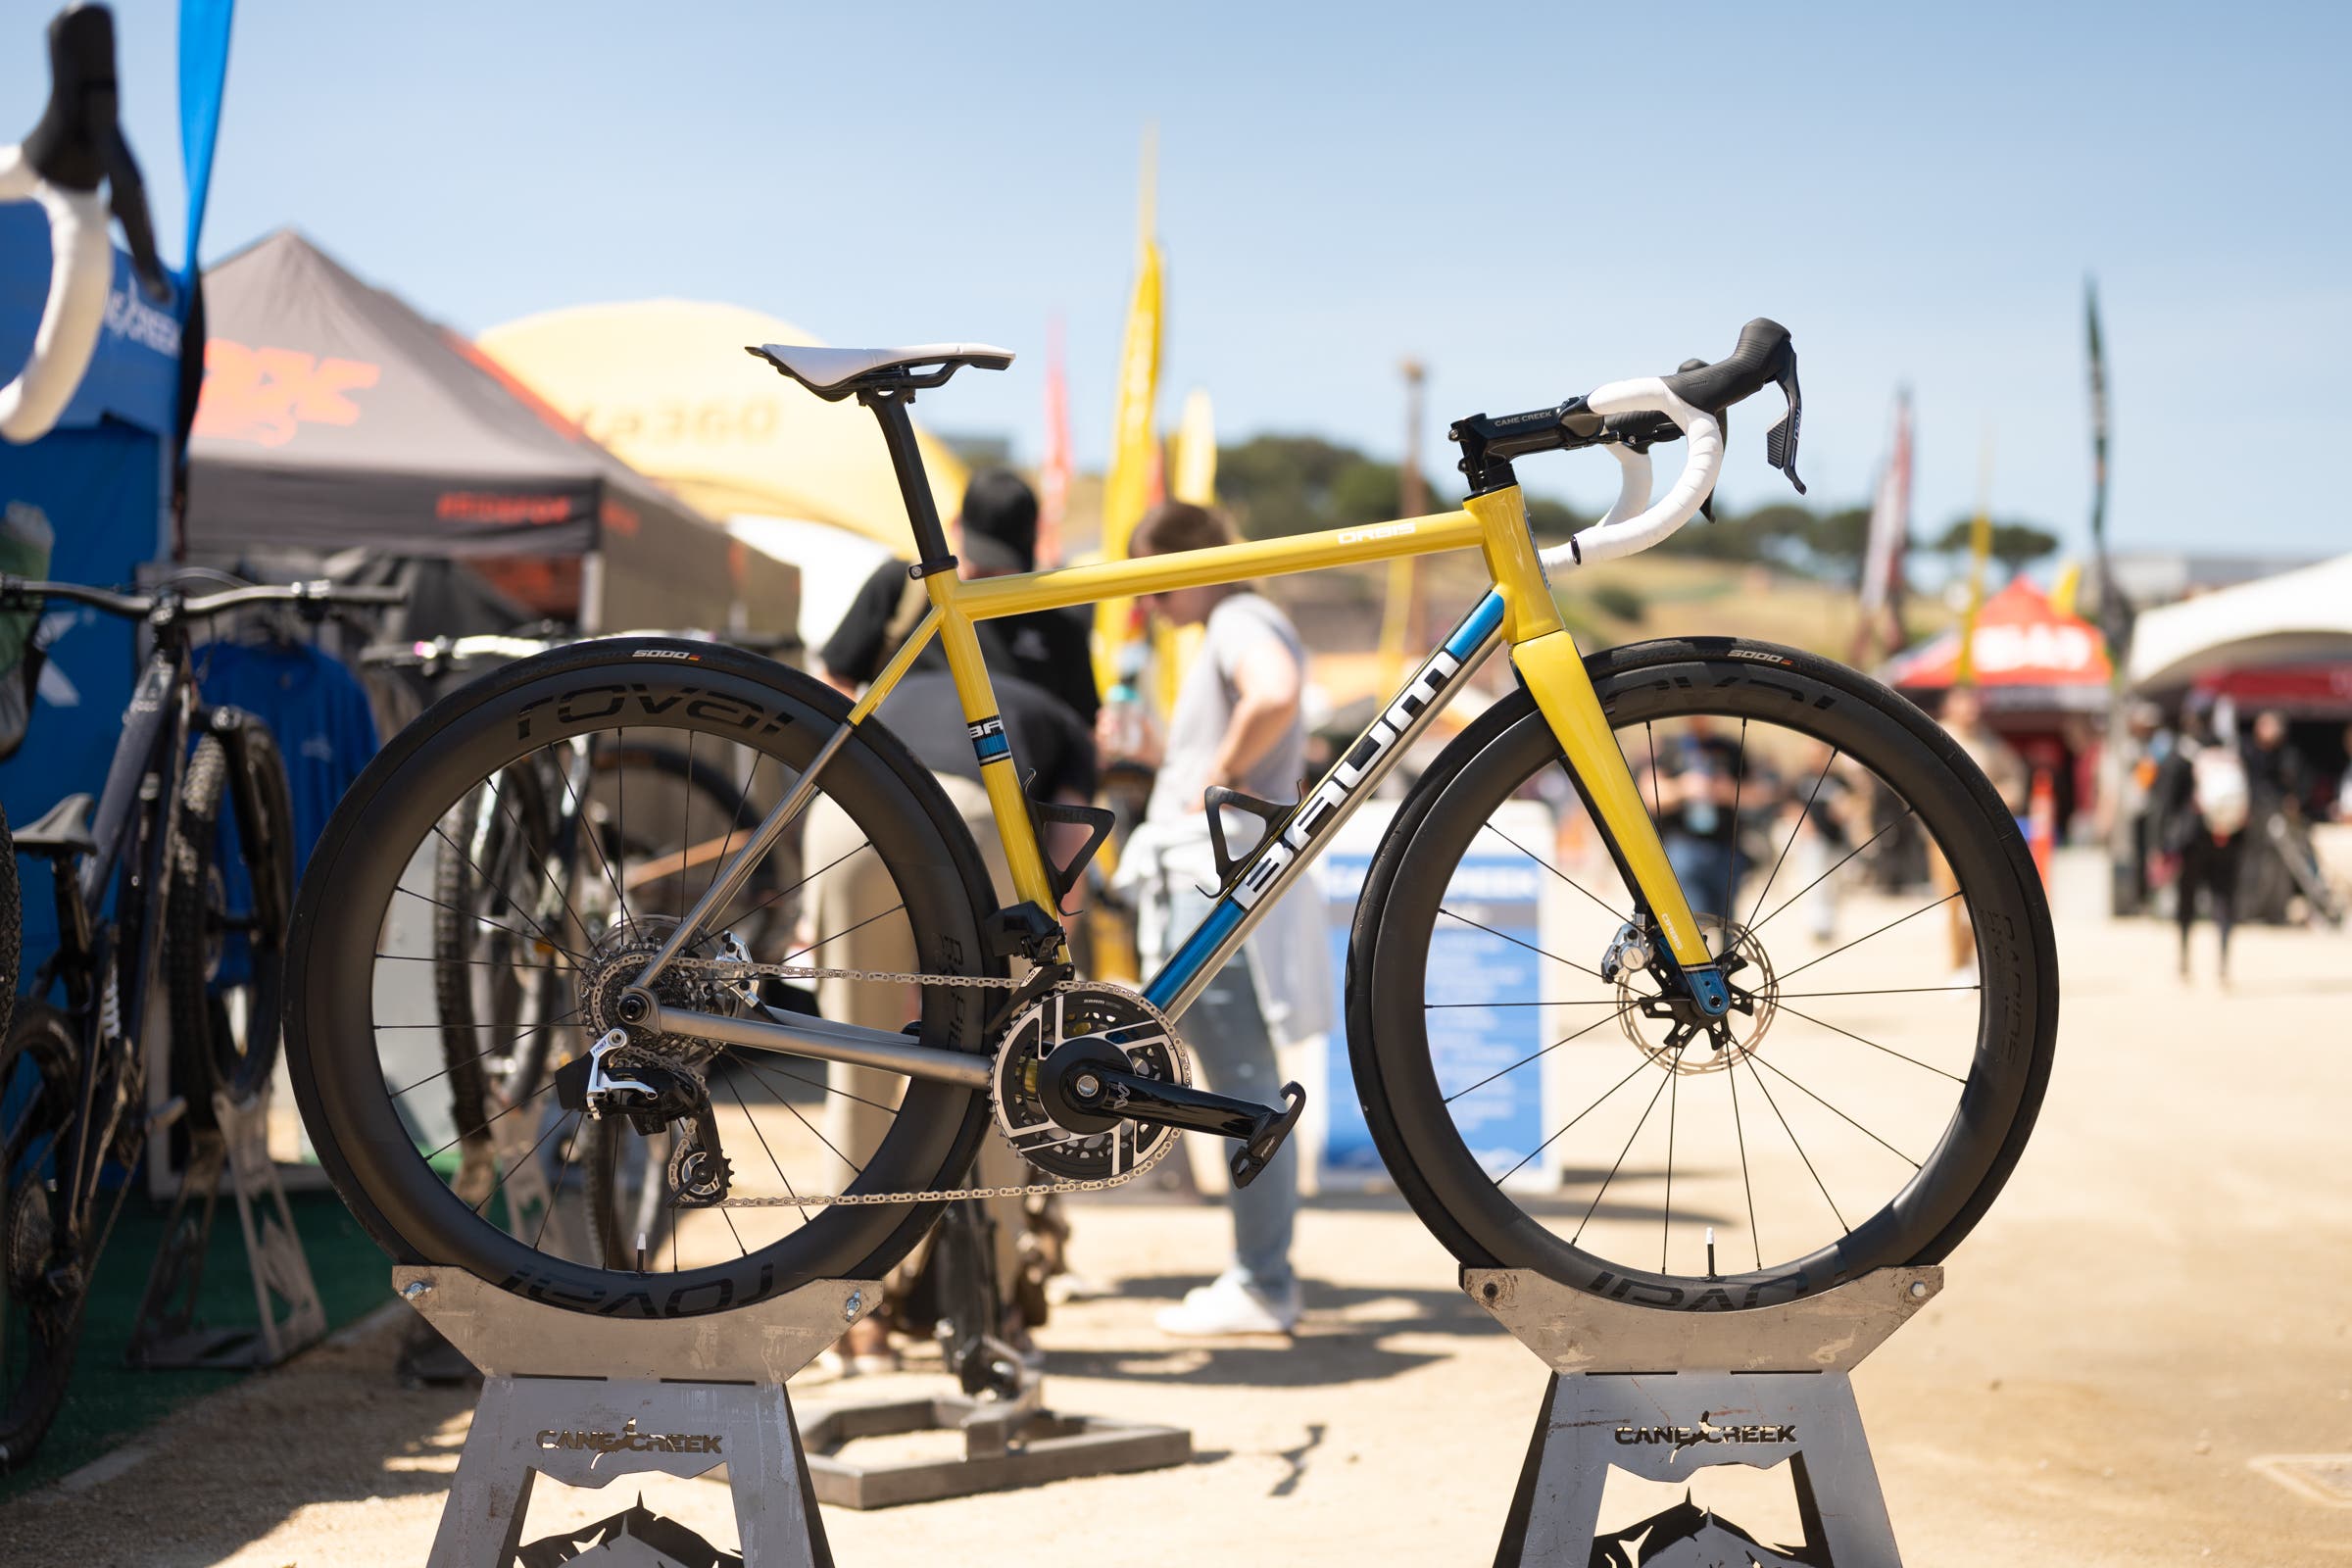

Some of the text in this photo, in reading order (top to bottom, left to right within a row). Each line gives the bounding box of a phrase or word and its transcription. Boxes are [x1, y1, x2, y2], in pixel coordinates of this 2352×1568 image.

[1494, 411, 1552, 427] CANE CREEK
[1338, 522, 1417, 545] ORBIS
[632, 649, 690, 660] 5000
[1727, 649, 1784, 663] 5000
[536, 1429, 616, 1451] CANE
[1614, 1425, 1796, 1445] CANE CREEK
